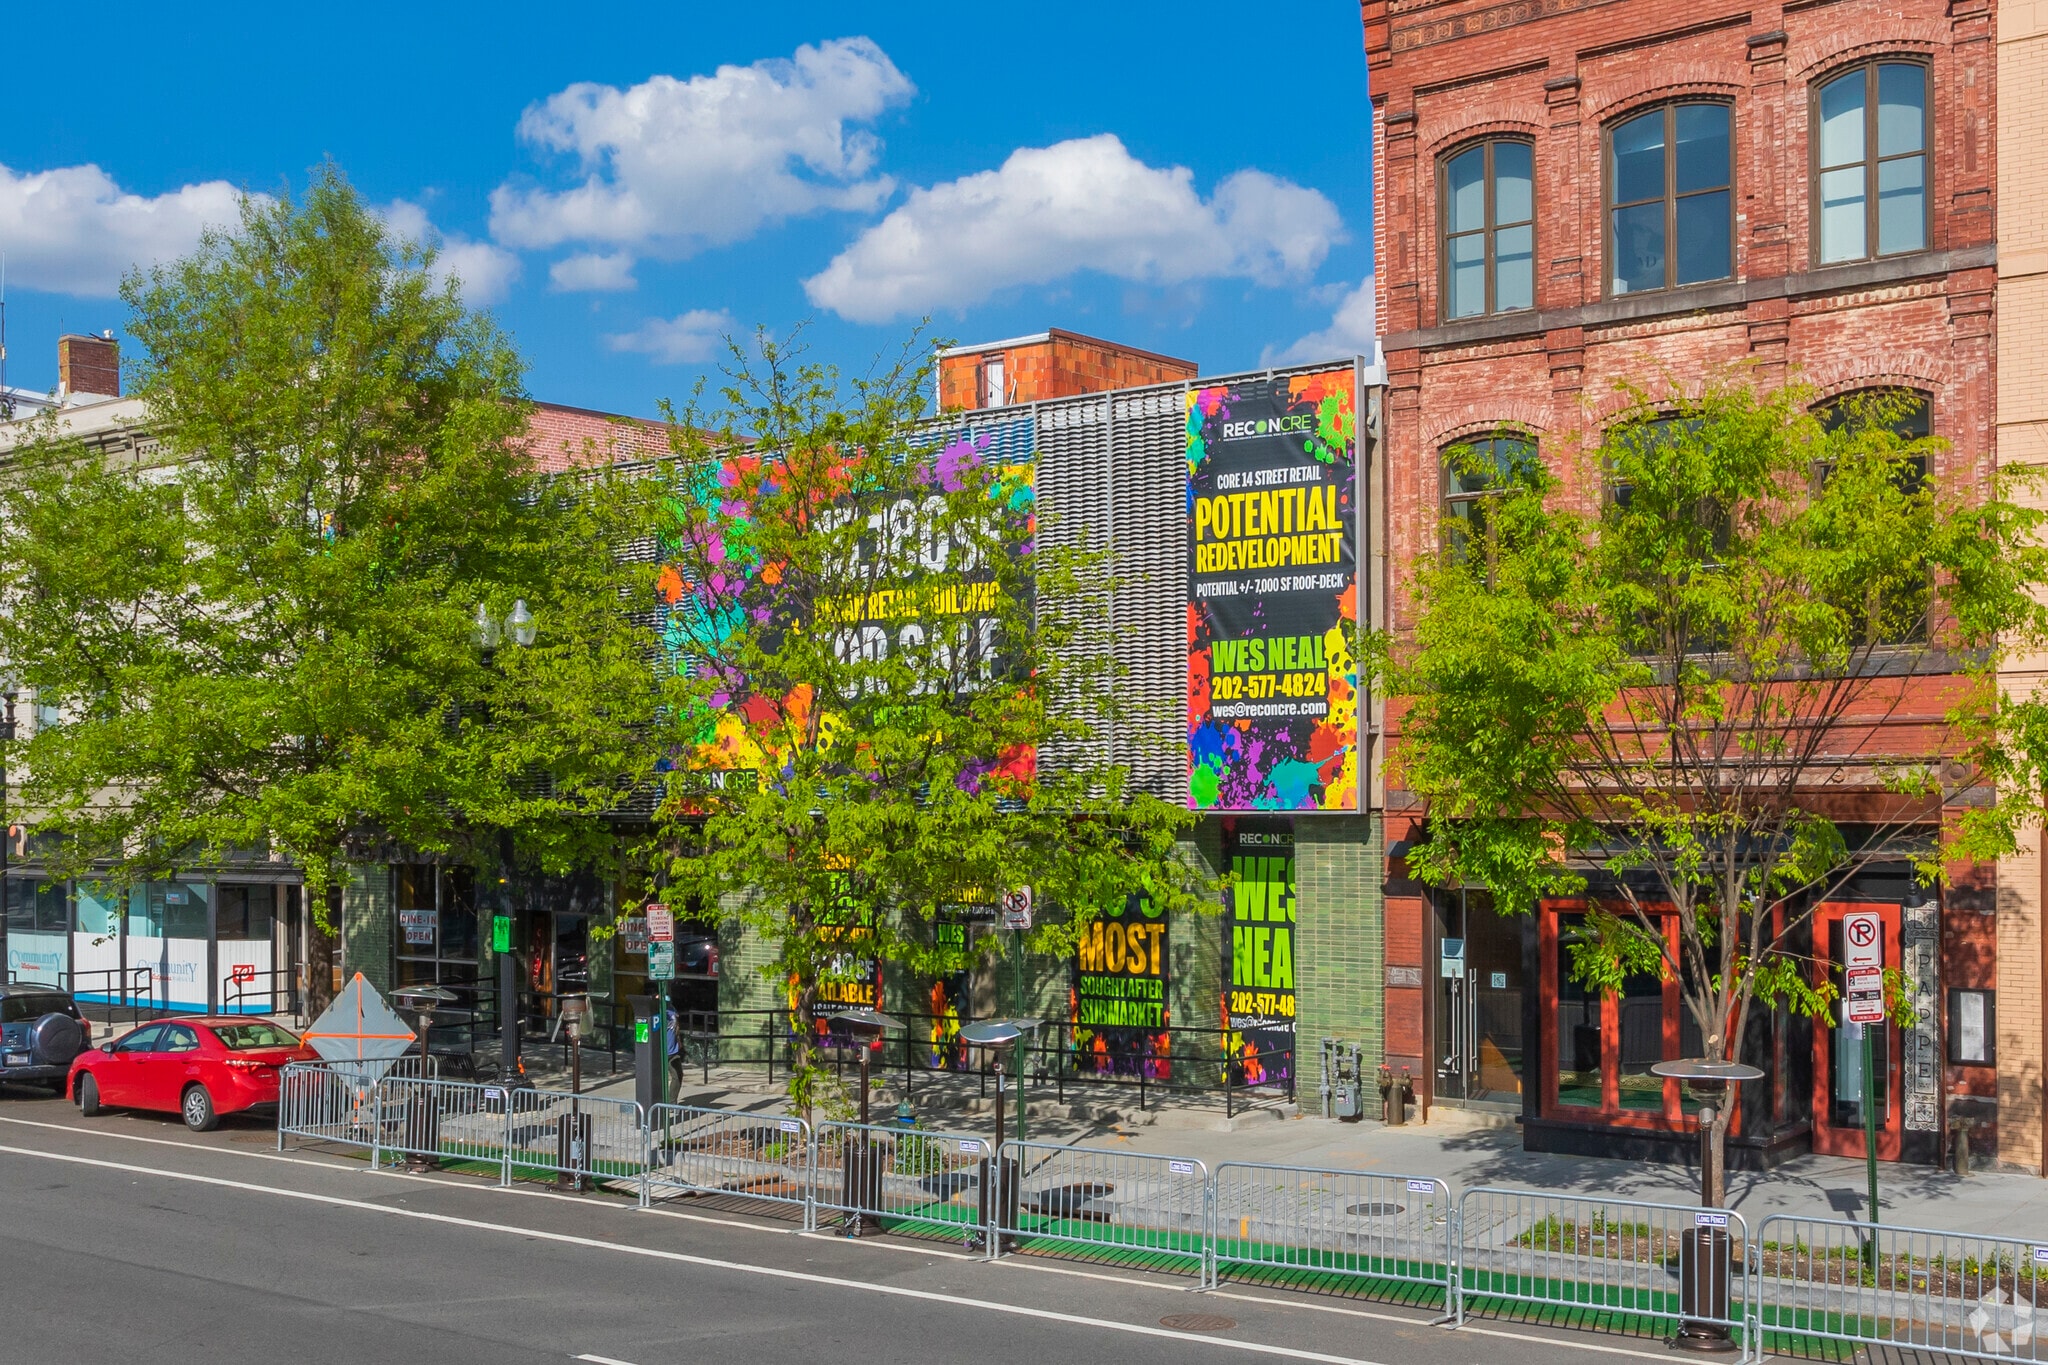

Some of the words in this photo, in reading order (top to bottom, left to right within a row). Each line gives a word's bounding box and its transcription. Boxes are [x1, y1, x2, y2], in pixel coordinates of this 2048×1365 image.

[1223, 414, 1312, 438] RECONCRE
[1217, 473, 1240, 489] CORE
[1241, 471, 1253, 487] 14
[1255, 468, 1289, 486] STREET
[1289, 465, 1321, 483] RETAIL
[1196, 484, 1343, 542] POTENTIAL
[1196, 532, 1343, 574] REDEVELOPMENT
[1197, 580, 1239, 598] POTENTIAL
[1255, 577, 1279, 595] 7,000
[1280, 576, 1292, 592] SF
[1293, 573, 1344, 591] ROOF-DECK
[1211, 638, 1265, 673] WES
[1269, 635, 1327, 671] NEAL
[1211, 672, 1327, 700] 202-577-4824
[1213, 701, 1327, 718] wes@reconcre.com
[401, 914, 437, 924] DINE-IN
[406, 931, 431, 941] OPEN
[626, 941, 647, 951] OPE
[938, 924, 965, 944] WES
[1080, 921, 1165, 975] MOST
[1232, 926, 1296, 989] NEA
[1080, 976, 1126, 997] SOUGHT
[1127, 978, 1163, 999] AFTER
[1081, 998, 1163, 1027] SUBMARKET
